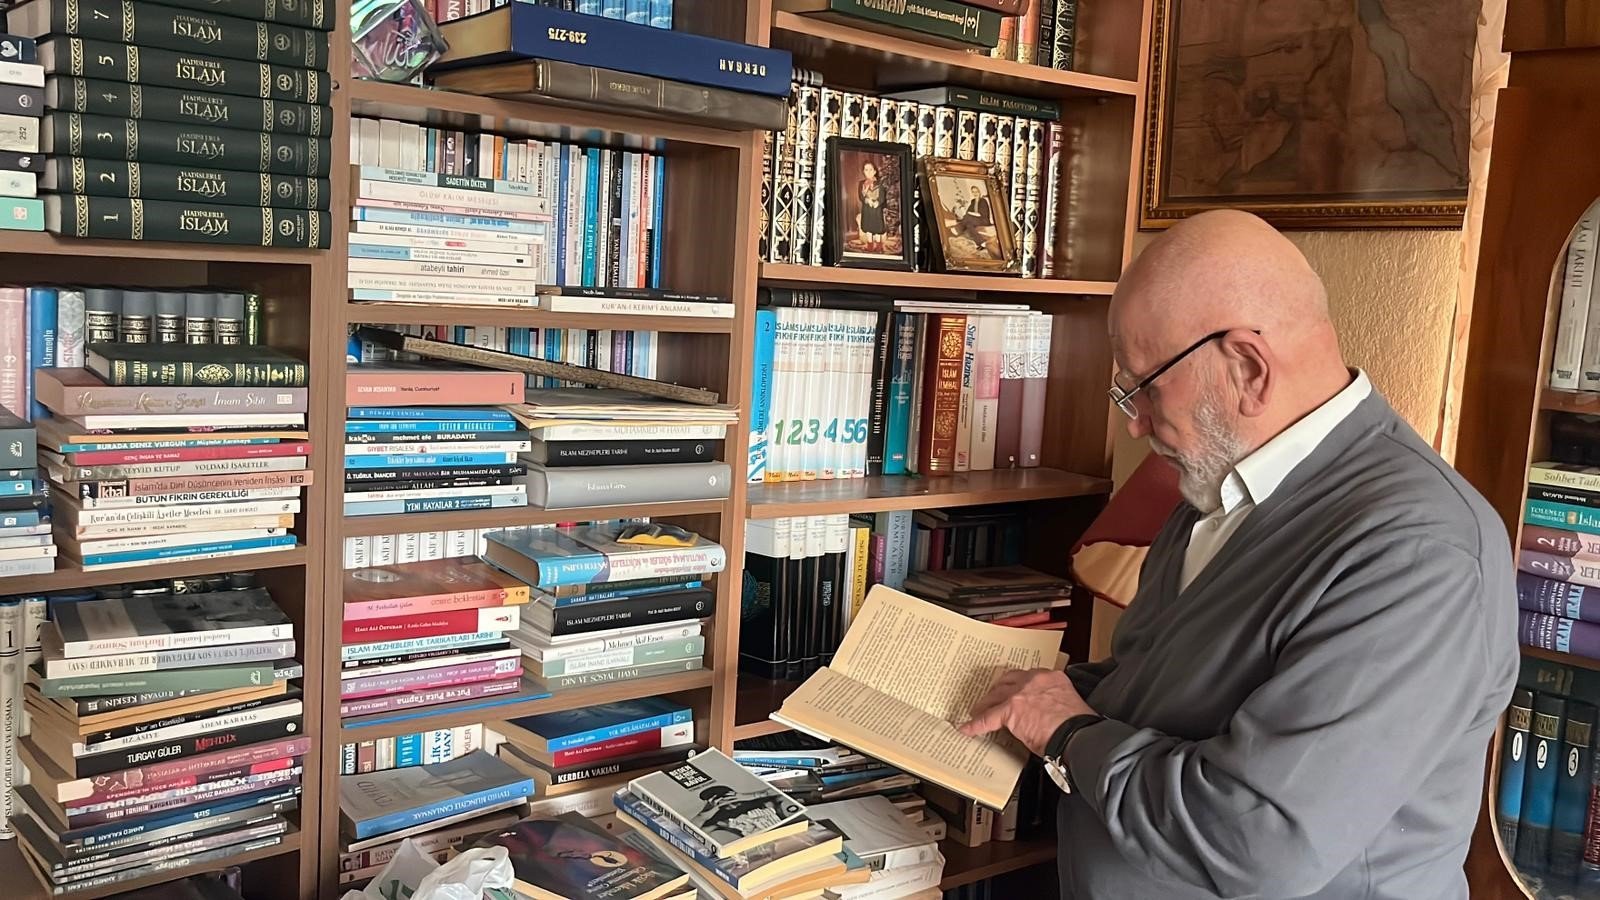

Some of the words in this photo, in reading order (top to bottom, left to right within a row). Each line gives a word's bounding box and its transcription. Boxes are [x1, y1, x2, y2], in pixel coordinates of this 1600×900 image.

[548, 27, 587, 44] 239-275
[719, 59, 766, 77] DERGAH
[962, 351, 975, 389] Hazinesi
[436, 433, 477, 441] BURADAYIZ
[775, 419, 785, 445] 1
[787, 419, 803, 445] 2
[803, 419, 820, 445] 3
[823, 418, 838, 443] 4
[840, 418, 855, 443] 5
[853, 418, 868, 443] 6
[1543, 471, 1576, 485] Sohbet
[1537, 537, 1556, 547] 2
[1531, 560, 1550, 571] 2
[91, 656, 136, 670] MUHAMMED
[396, 693, 425, 705] Tapma
[127, 749, 157, 764] TURGAY
[157, 744, 182, 757] GÜLER
[1537, 745, 1546, 765] 2
[1569, 751, 1577, 772] 3
[557, 769, 590, 784] KERBELA
[591, 763, 620, 777] VAKIASI
